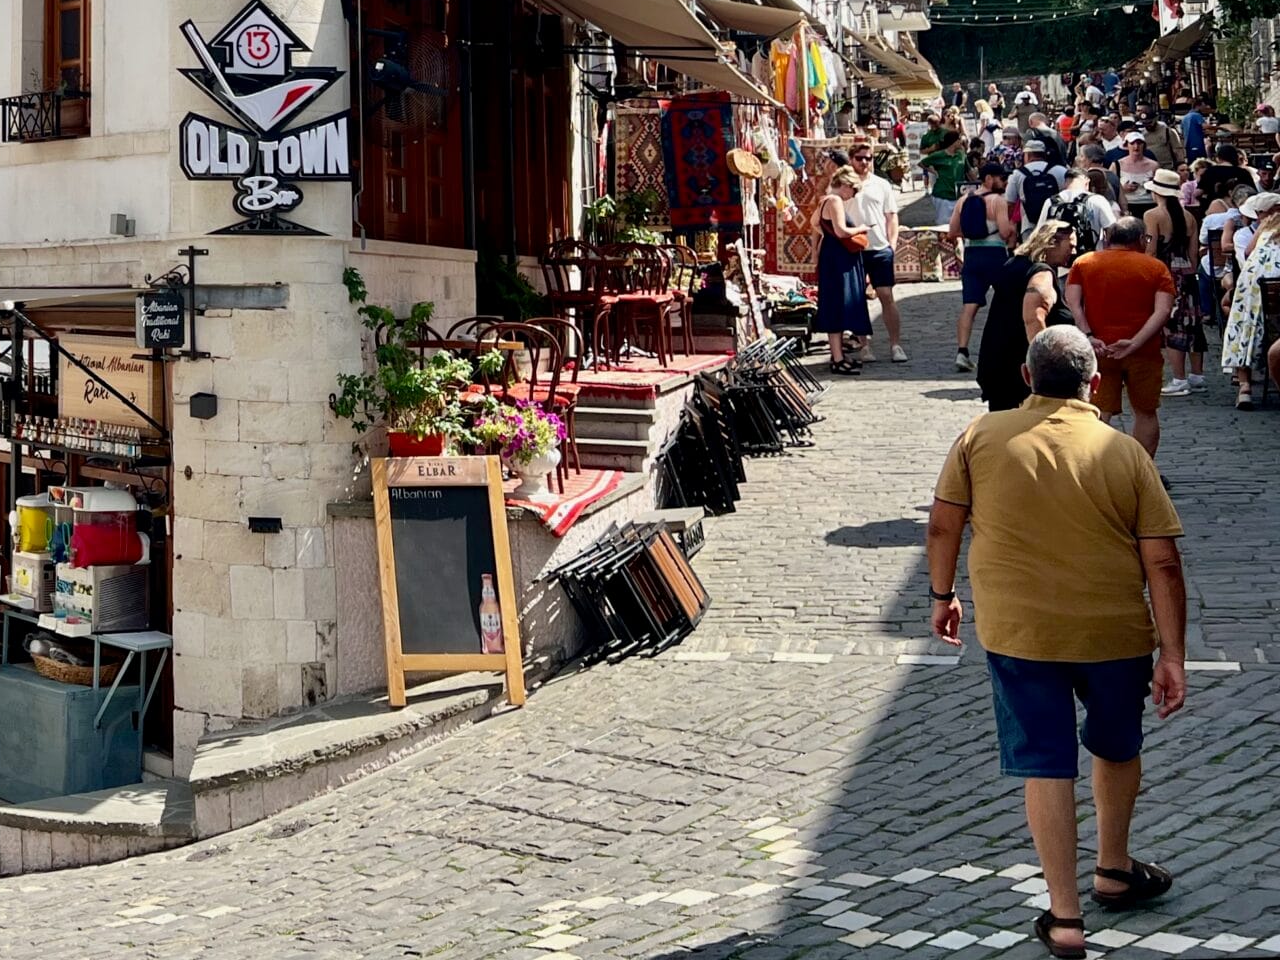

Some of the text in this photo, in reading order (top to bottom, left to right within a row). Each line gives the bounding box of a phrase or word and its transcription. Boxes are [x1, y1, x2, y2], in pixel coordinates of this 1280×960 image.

[246, 31, 270, 60] 13
[187, 117, 349, 174] OLD TOWN
[241, 176, 299, 211] Bar
[141, 300, 178, 313] Albanian
[141, 314, 180, 327] Traditional
[151, 328, 170, 342] Raki
[107, 356, 144, 373] Albanian
[418, 464, 456, 477] ELBAR
